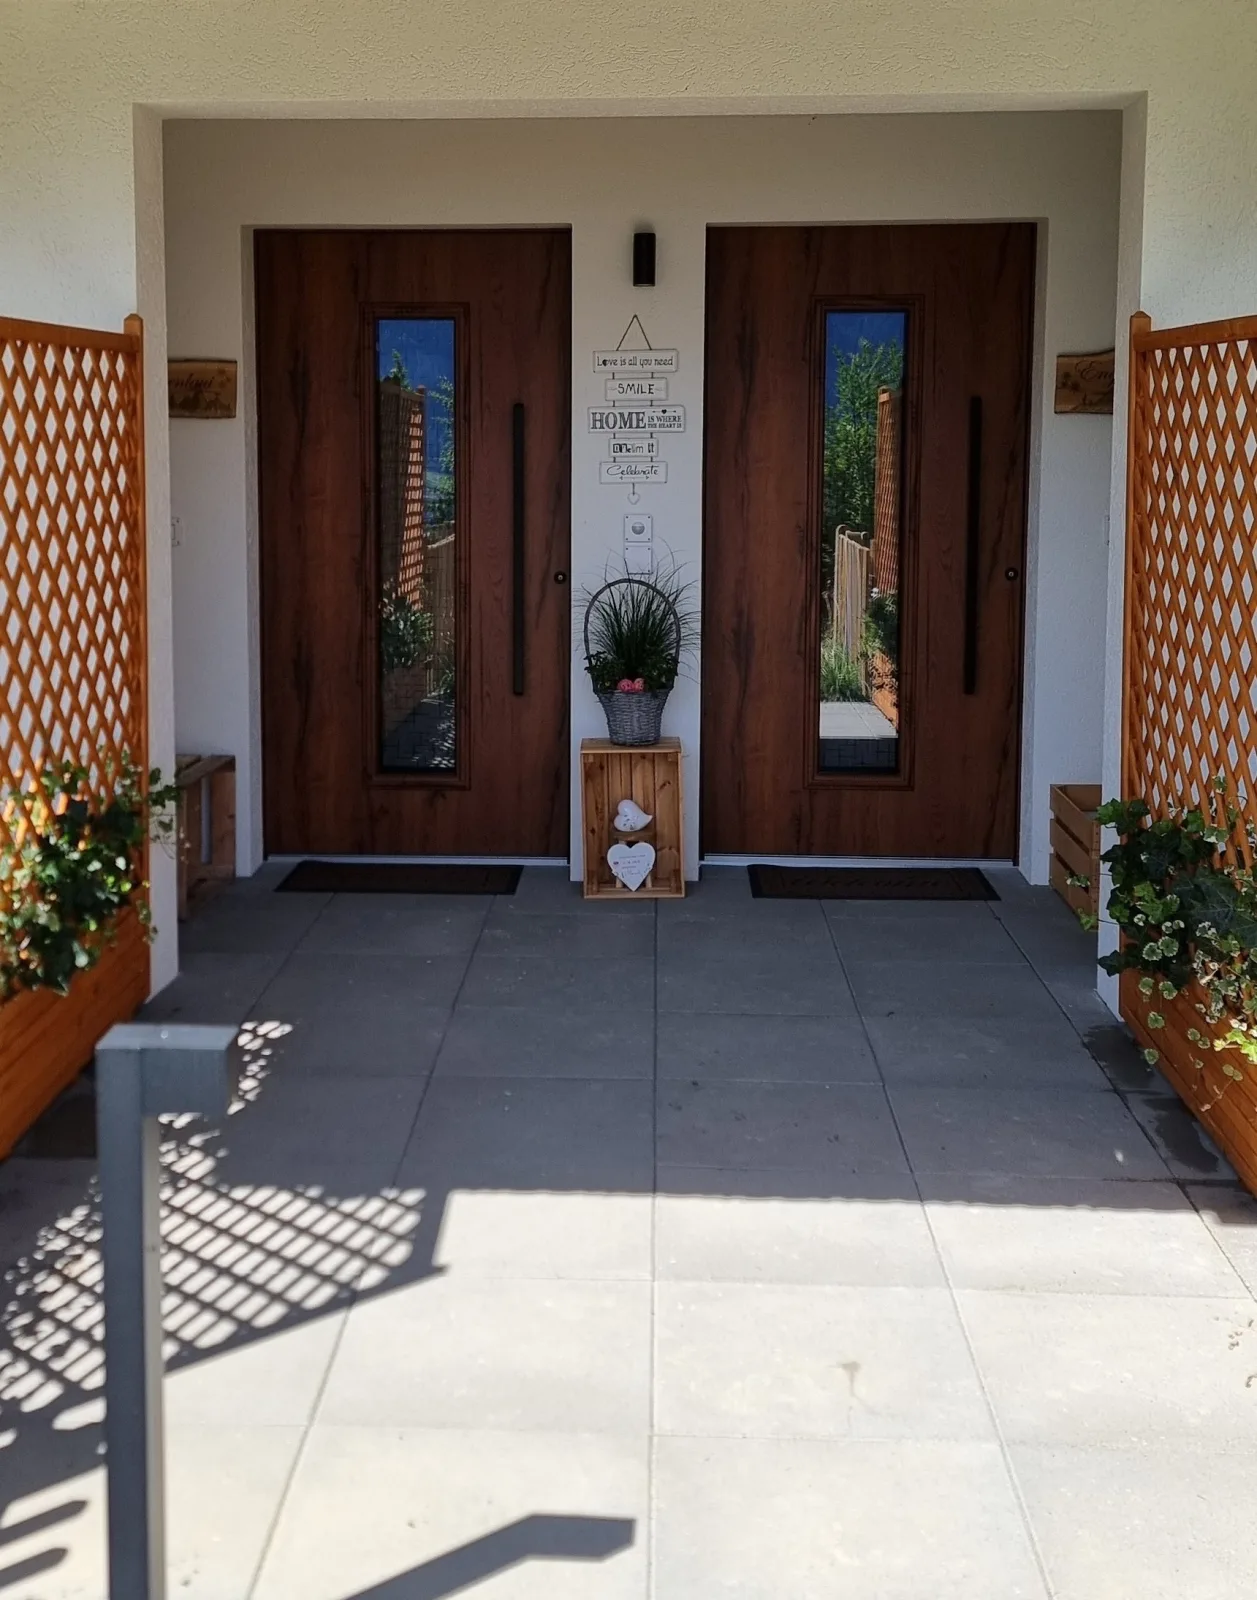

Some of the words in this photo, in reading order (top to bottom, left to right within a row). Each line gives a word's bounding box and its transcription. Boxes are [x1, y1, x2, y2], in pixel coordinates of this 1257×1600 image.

[597, 356, 618, 367] Love
[620, 356, 627, 366] is
[628, 356, 637, 366] all
[640, 359, 653, 369] you
[654, 356, 673, 366] need
[617, 383, 655, 394] SMILE
[591, 411, 646, 429] HOME
[607, 465, 659, 475] Celebrate
